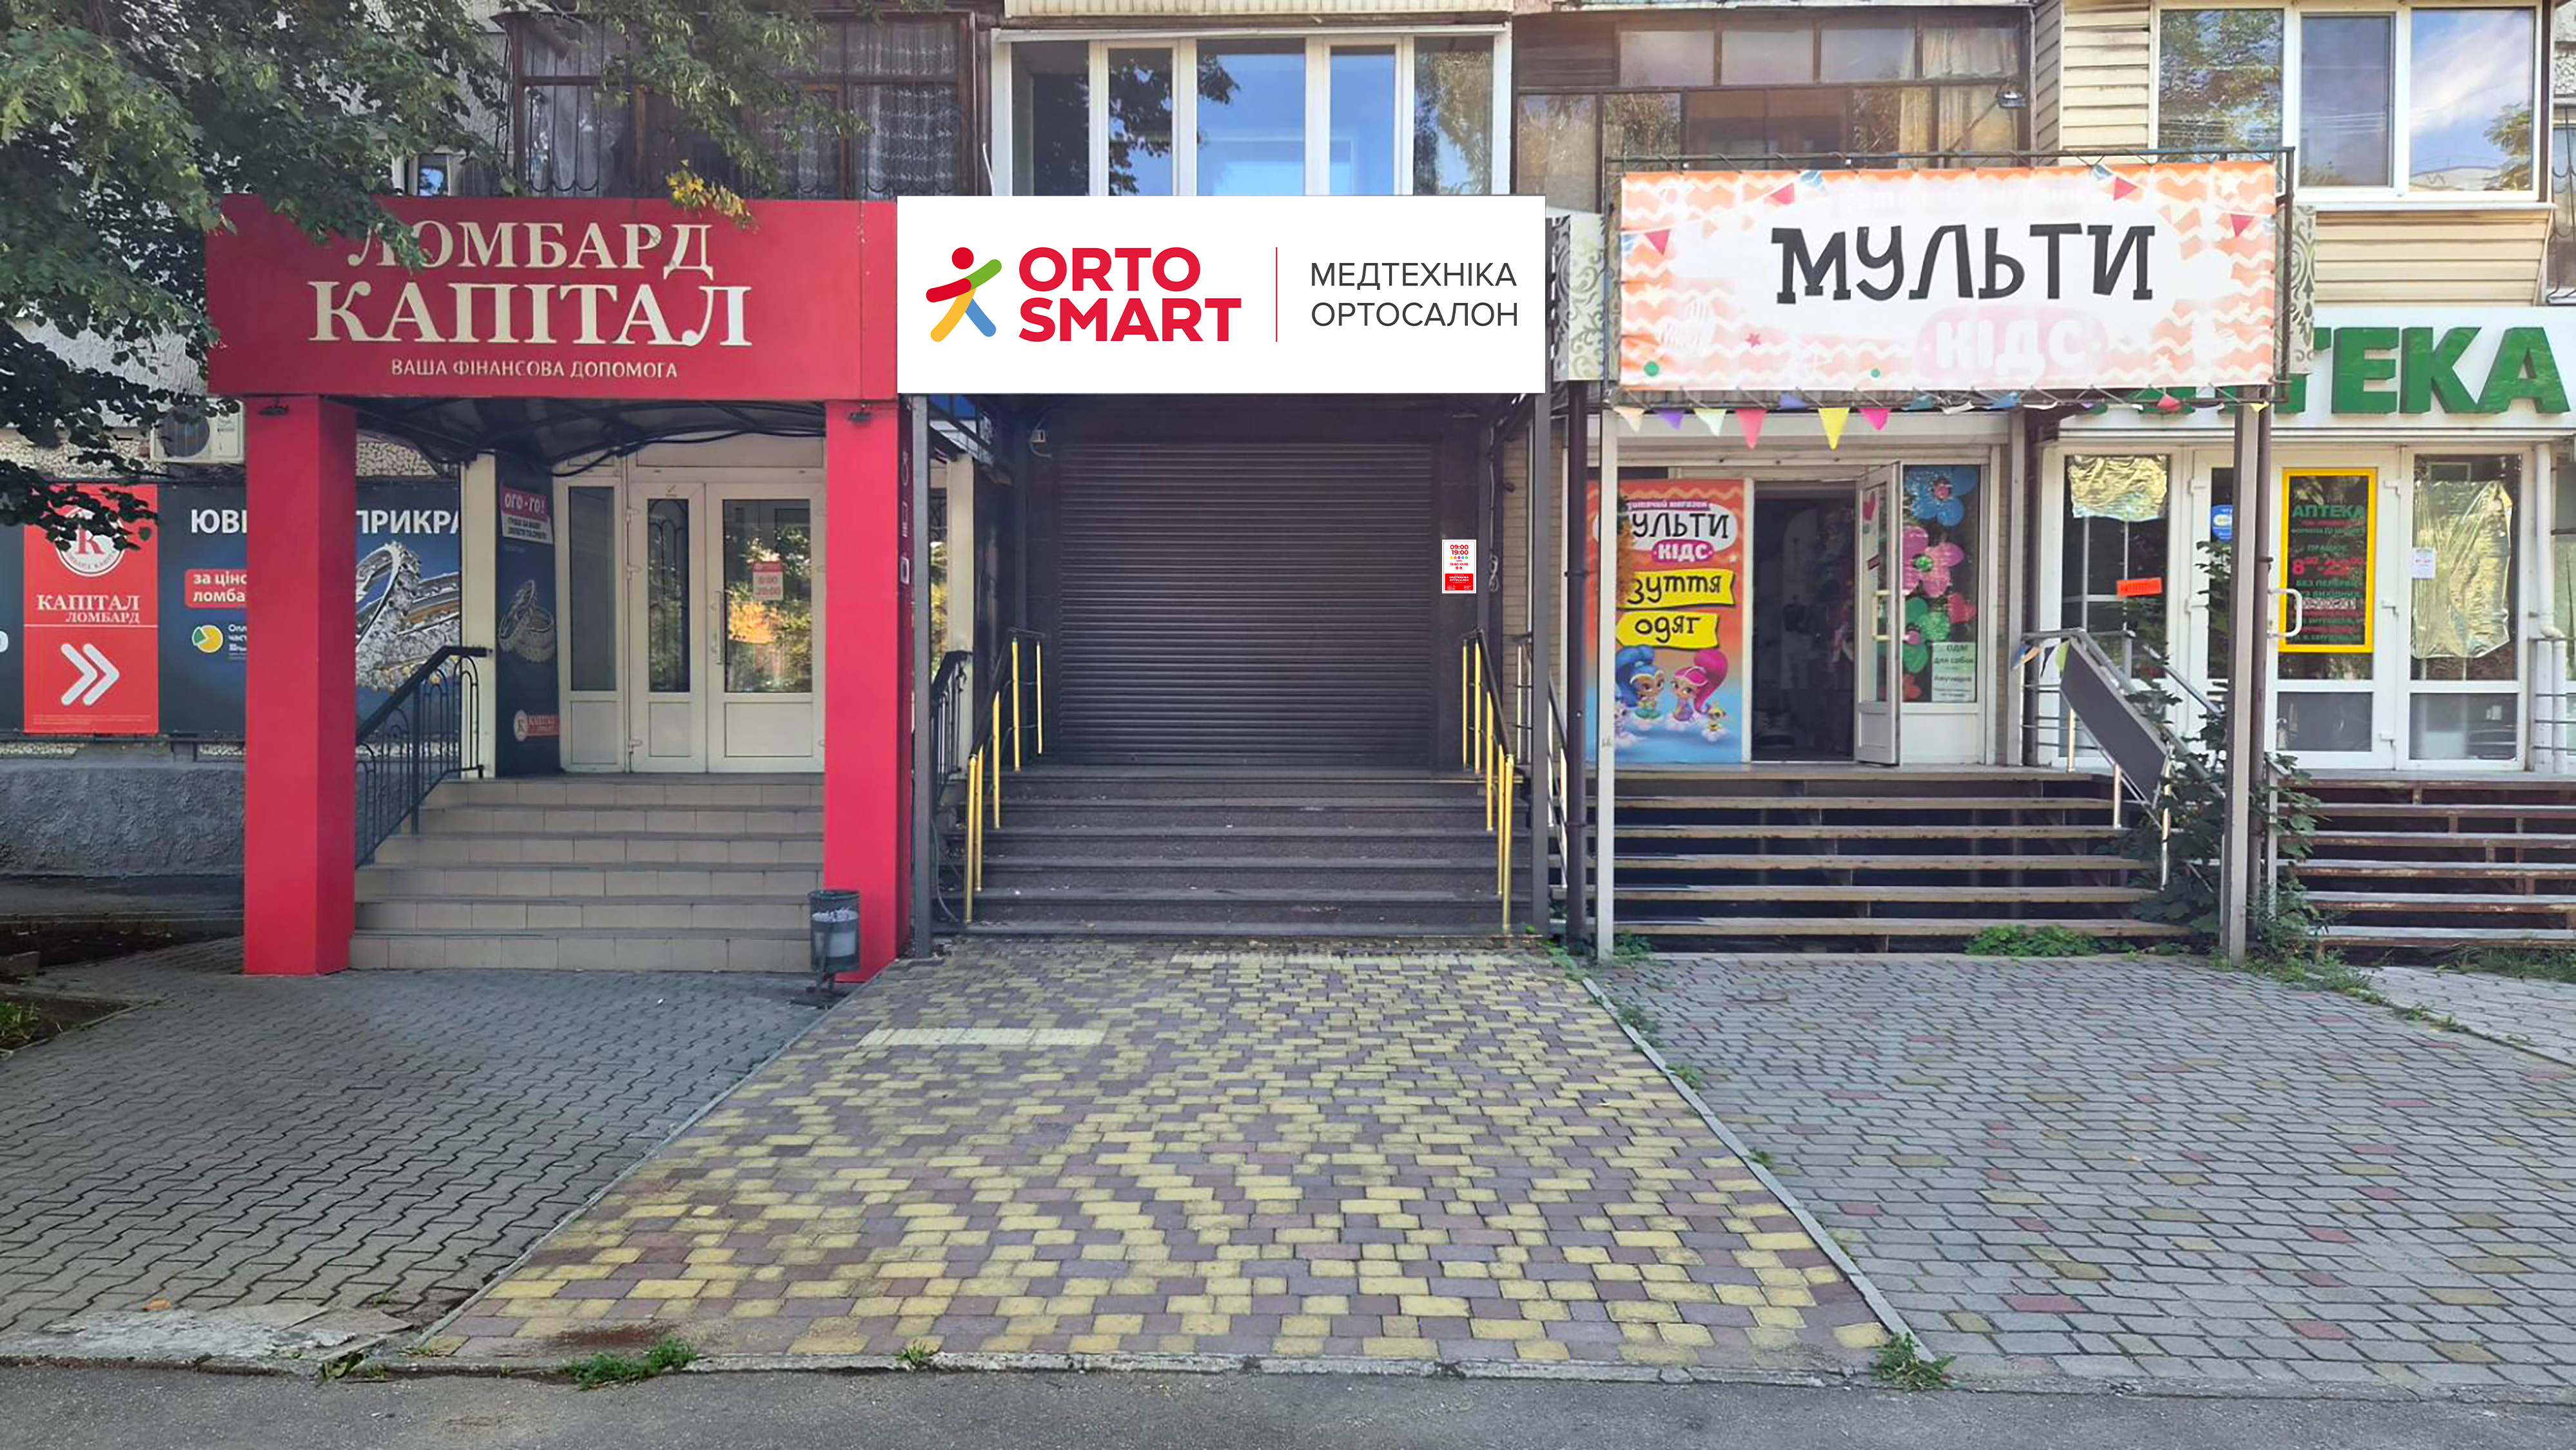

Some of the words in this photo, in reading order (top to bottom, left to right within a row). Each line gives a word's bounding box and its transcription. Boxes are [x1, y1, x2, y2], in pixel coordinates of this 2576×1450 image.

[347, 220, 714, 280] ЛОМБАРД
[1771, 222, 2156, 305] МУЛЬТИ
[1019, 247, 1201, 292] ORTO
[1311, 262, 1517, 291] МЕДТЕХНІКА
[307, 280, 753, 347] КАПІТАЛ
[1019, 298, 1242, 342] SMART
[1311, 302, 1519, 327] ОРТОСАЛОН
[1936, 320, 2086, 376] КІДС
[391, 359, 447, 375] ВАША
[453, 360, 565, 377] ФІНАНСОВА
[570, 362, 678, 379] ДОПОМОГА
[2292, 504, 2365, 518] АПТЕКА
[1632, 512, 1729, 539] УЛЬТИ
[1658, 543, 1710, 563] КІДС
[193, 573, 211, 585] за
[1626, 575, 1721, 604] зуття
[37, 594, 140, 611] КАПІТАЛ
[65, 611, 141, 624] ЛОМБАРД
[1634, 616, 1701, 644] одяг
